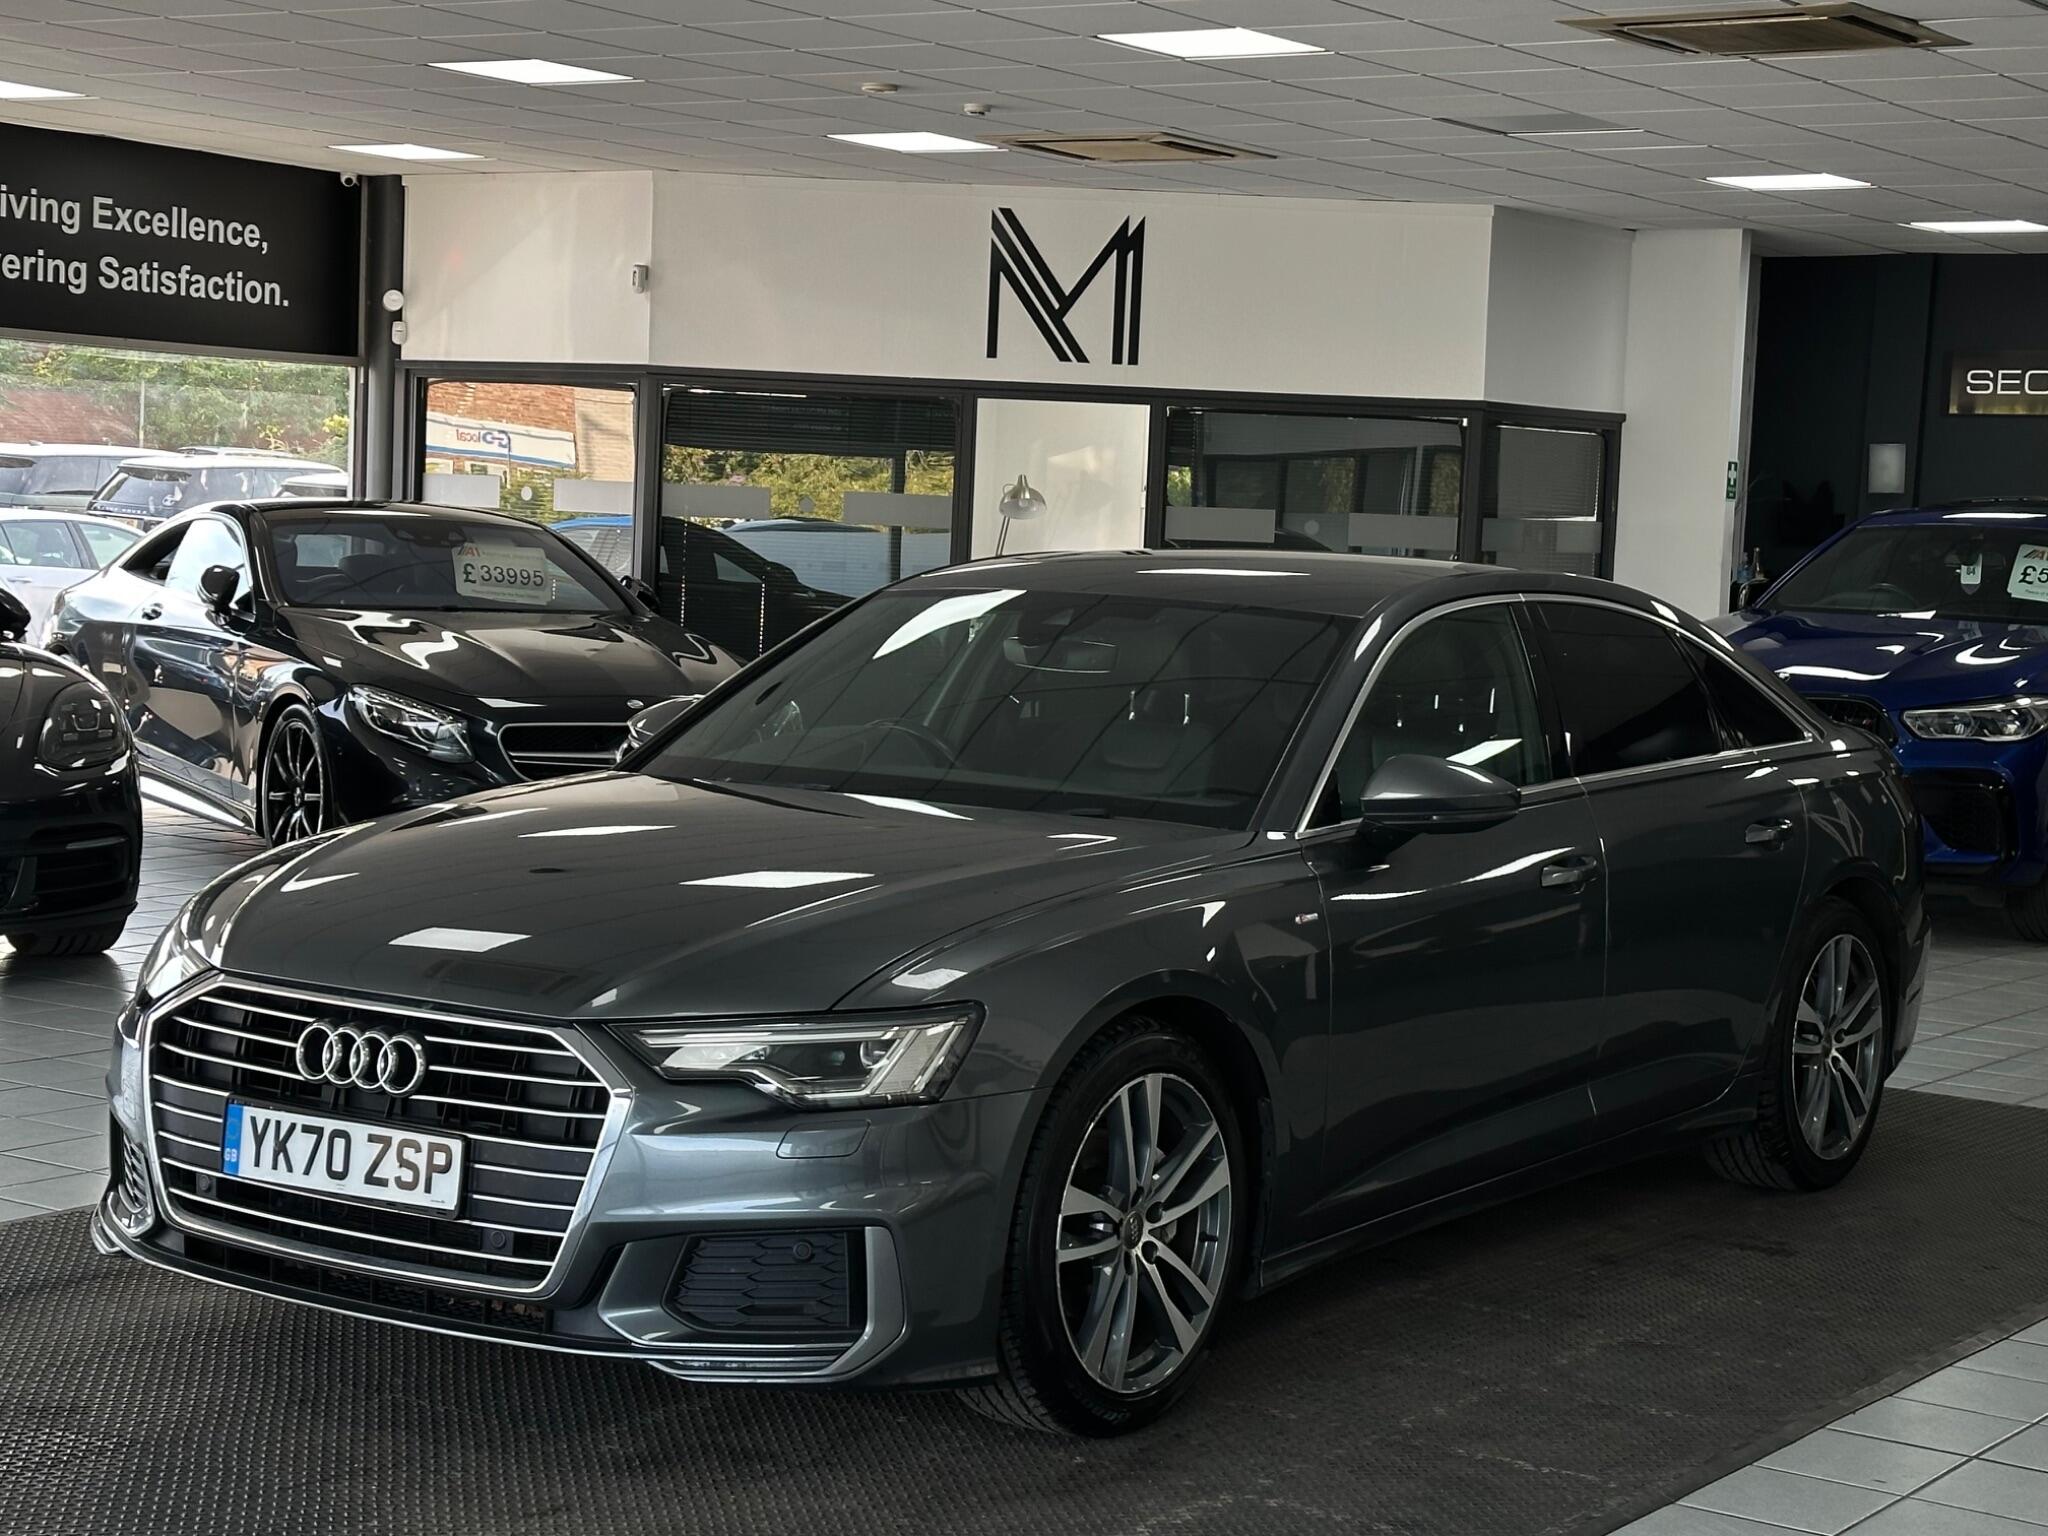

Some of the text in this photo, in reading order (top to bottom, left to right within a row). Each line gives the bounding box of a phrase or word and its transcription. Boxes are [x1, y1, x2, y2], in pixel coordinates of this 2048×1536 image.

[93, 196, 268, 254] Excellence,
[0, 249, 289, 307] ering Satisfaction.
[463, 563, 544, 587] £33995
[250, 1116, 453, 1194] YK70 ZSP
